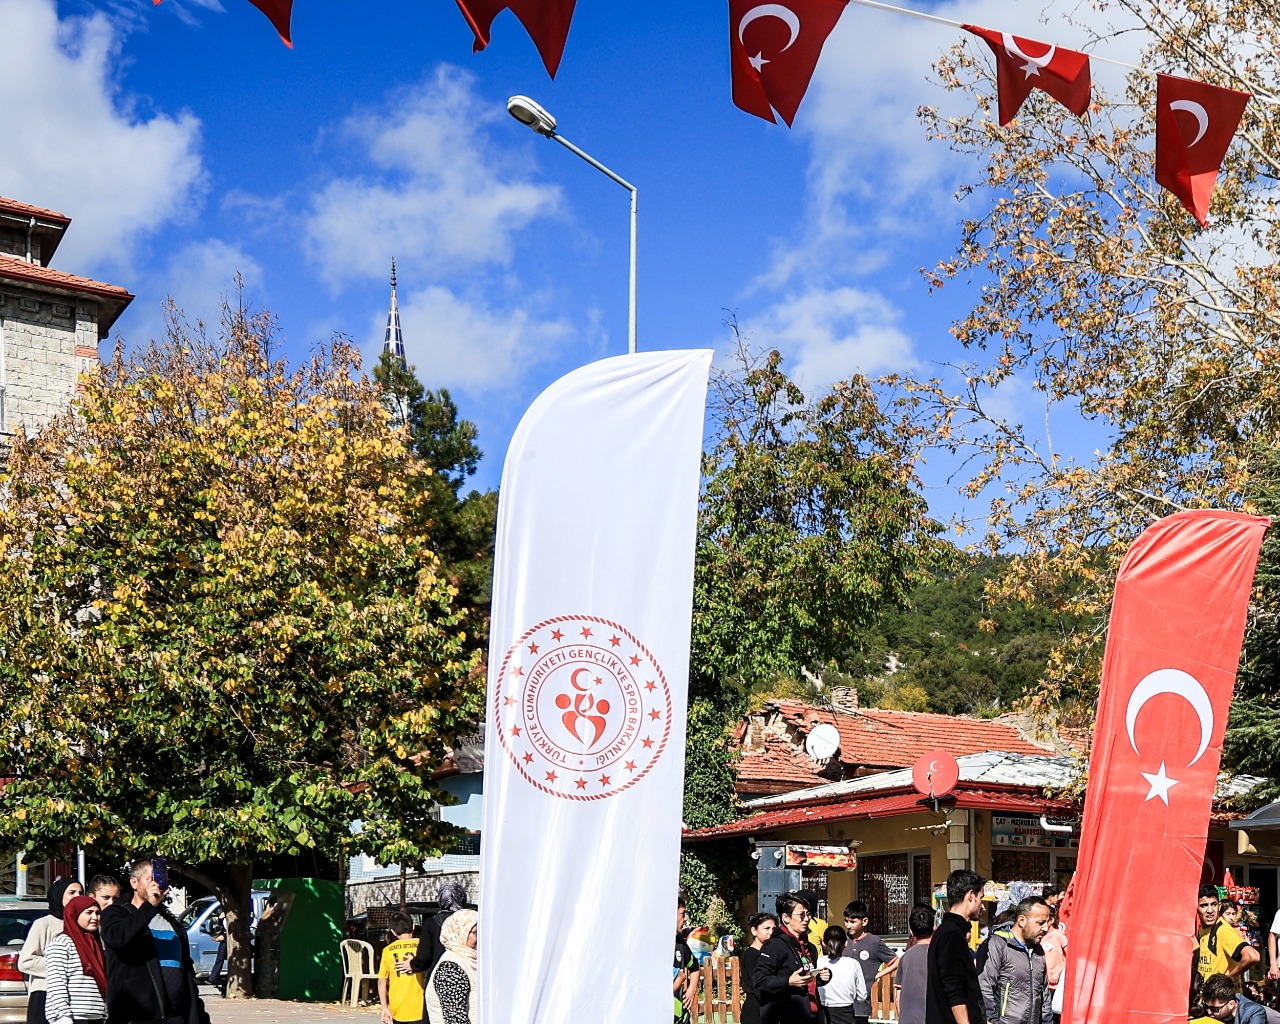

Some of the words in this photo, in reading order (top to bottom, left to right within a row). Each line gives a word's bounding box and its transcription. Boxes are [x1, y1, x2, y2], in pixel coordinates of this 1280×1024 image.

[568, 649, 617, 669] GENÇLİK
[617, 667, 629, 683] VE
[527, 650, 567, 721] CUMHURİYETİ
[623, 683, 638, 715] SPOR
[529, 722, 567, 765] TÜRKİYE
[596, 717, 638, 766] BAKANLIĞI
